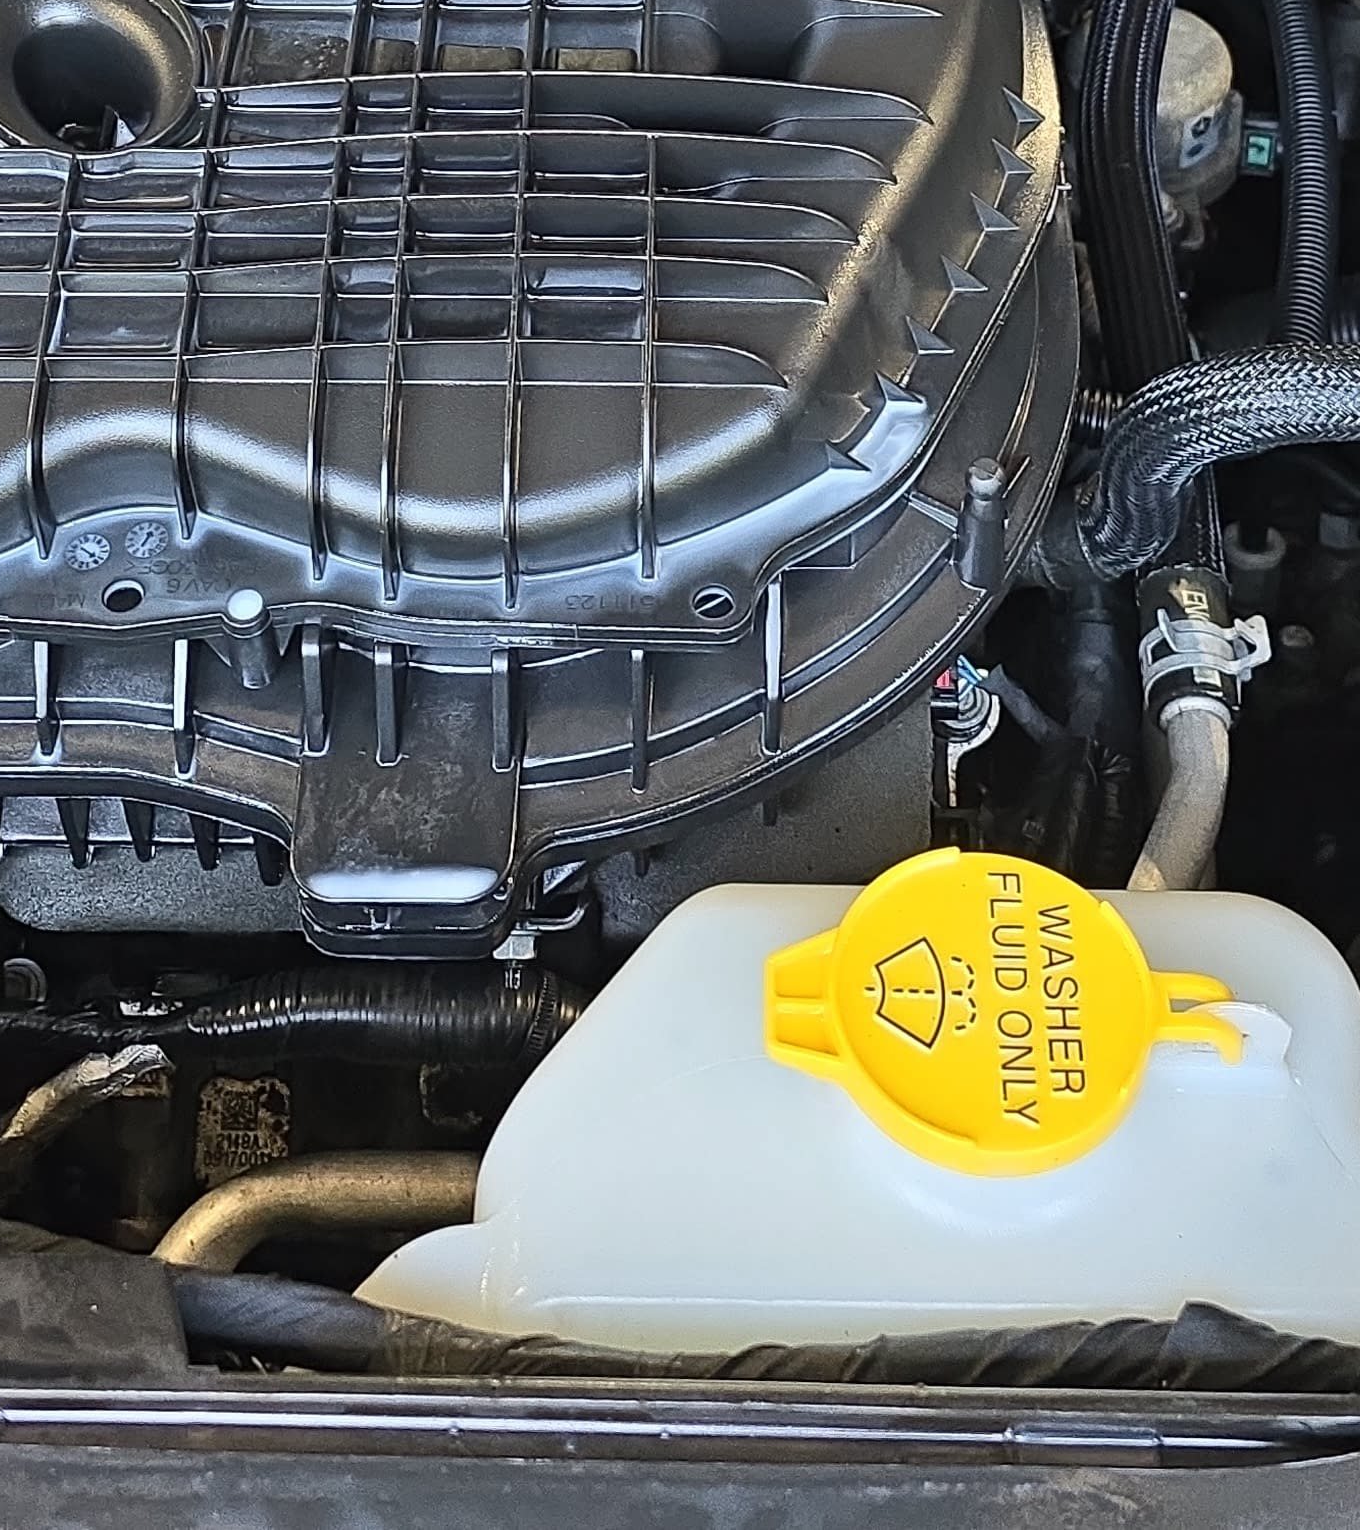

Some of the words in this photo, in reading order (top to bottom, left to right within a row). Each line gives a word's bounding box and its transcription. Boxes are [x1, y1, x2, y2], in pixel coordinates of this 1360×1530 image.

[986, 870, 1028, 994] FLUID
[1036, 903, 1088, 1097] WASHER
[995, 1011, 1041, 1126] ONLY
